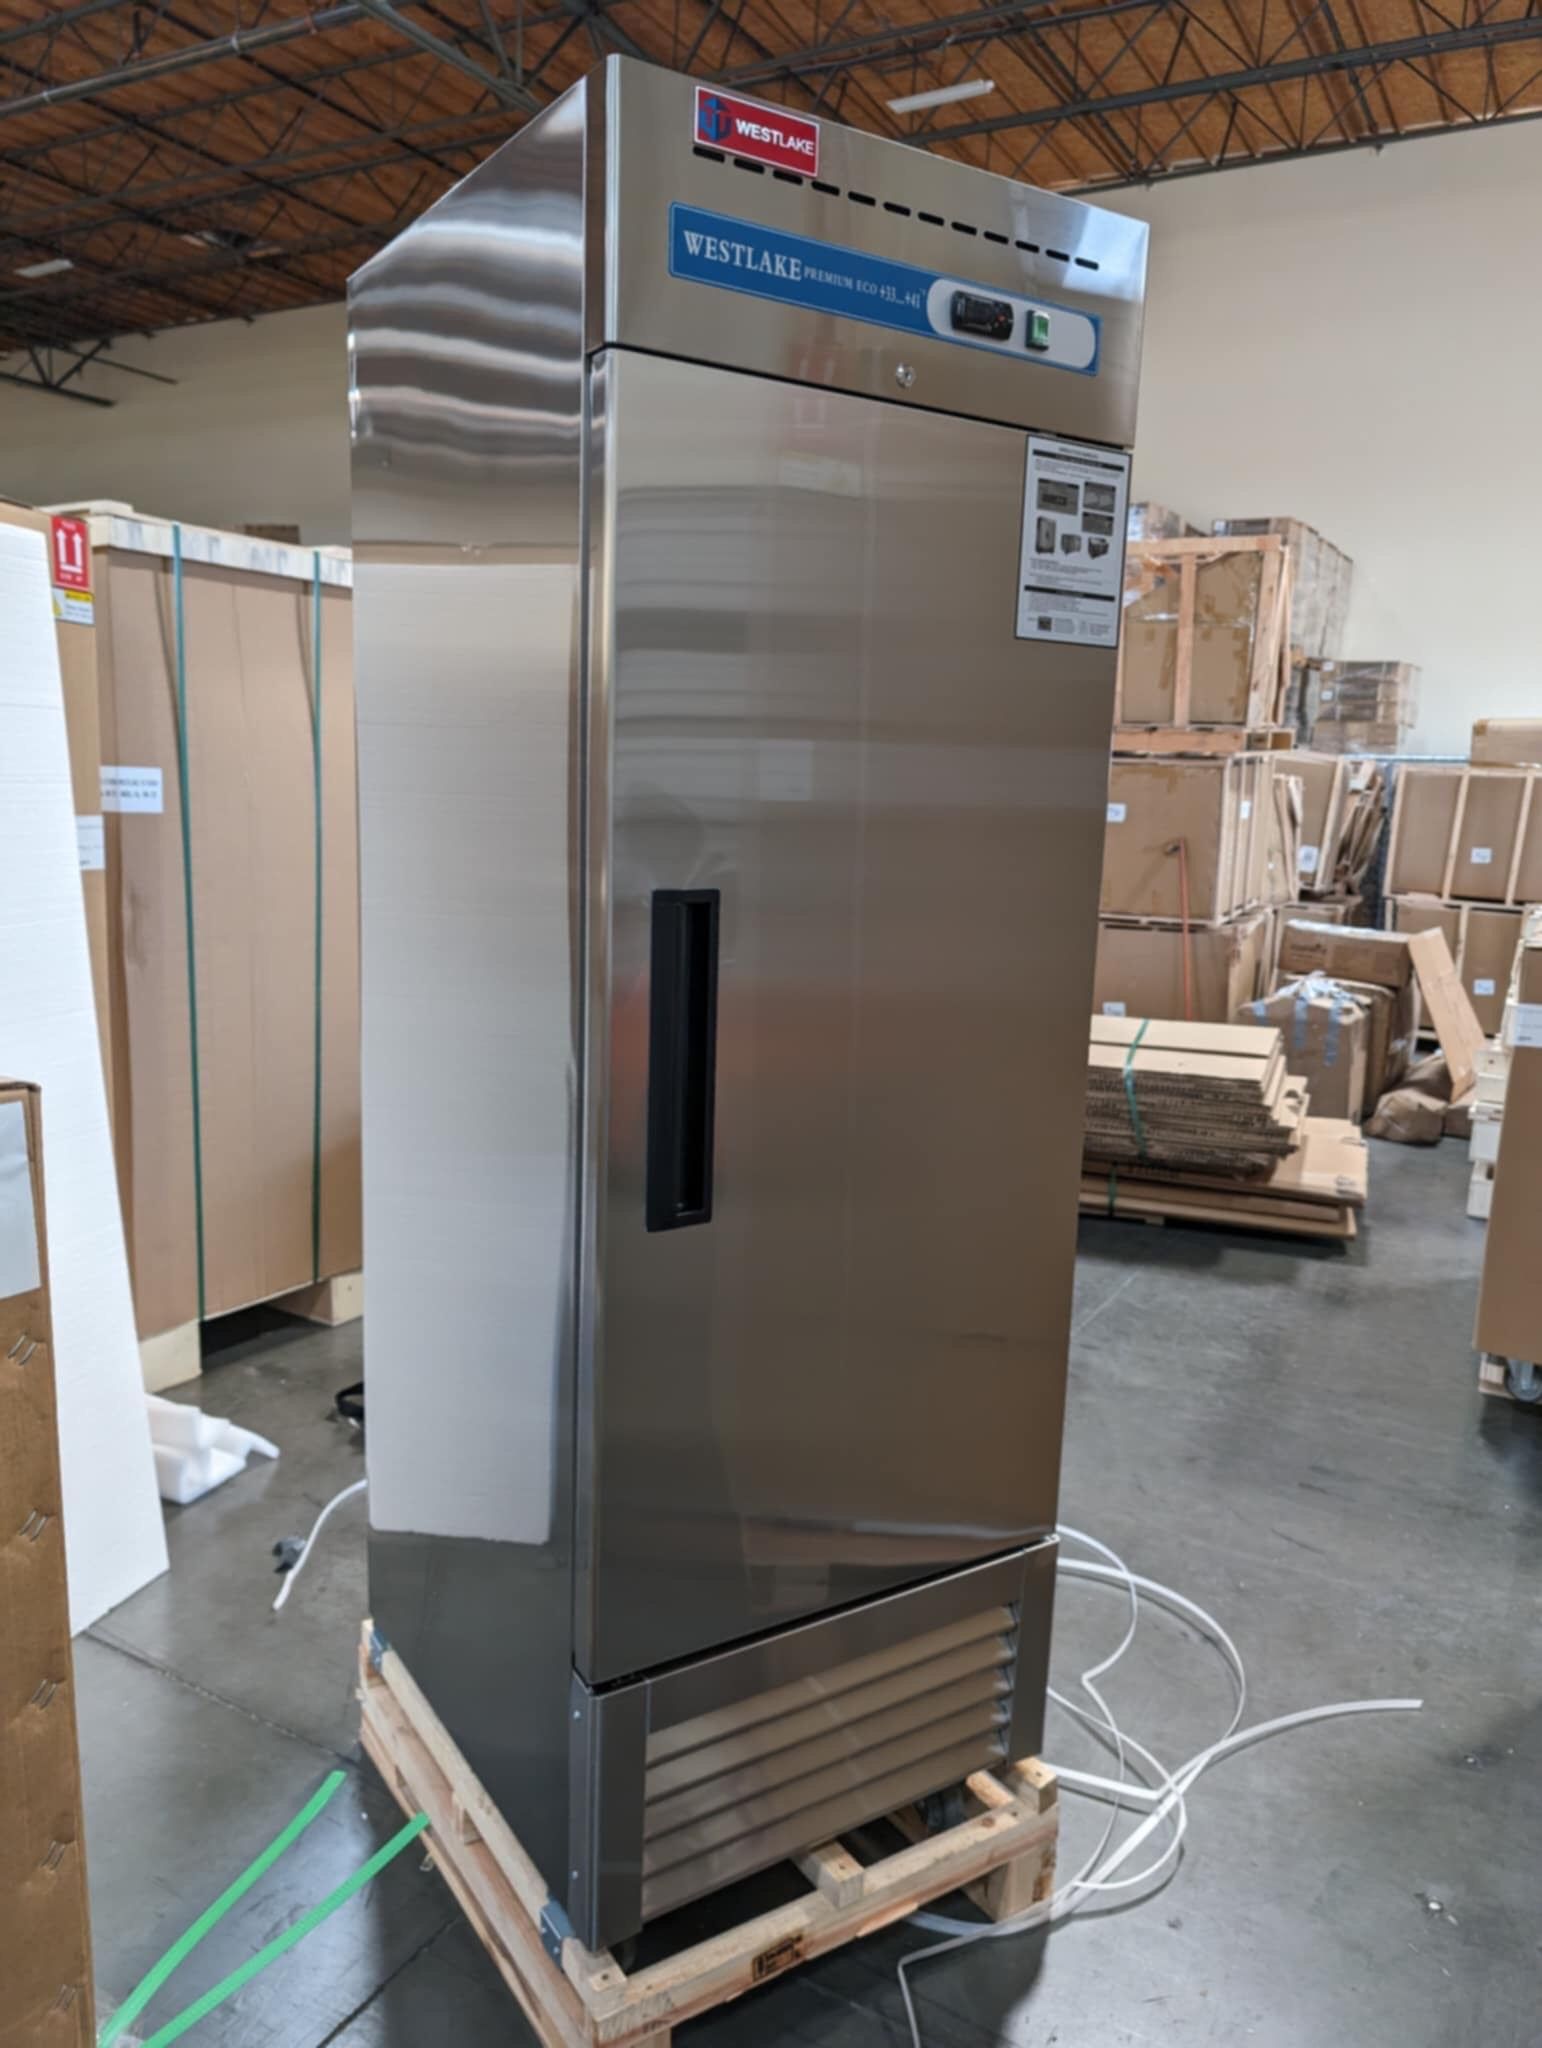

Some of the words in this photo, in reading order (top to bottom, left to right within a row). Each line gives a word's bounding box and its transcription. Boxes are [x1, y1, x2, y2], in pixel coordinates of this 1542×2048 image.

[735, 118, 814, 156] WESTLAKE
[683, 230, 802, 281] WESTLAKE
[804, 266, 853, 290] PREMIUM
[856, 279, 878, 296] ECO
